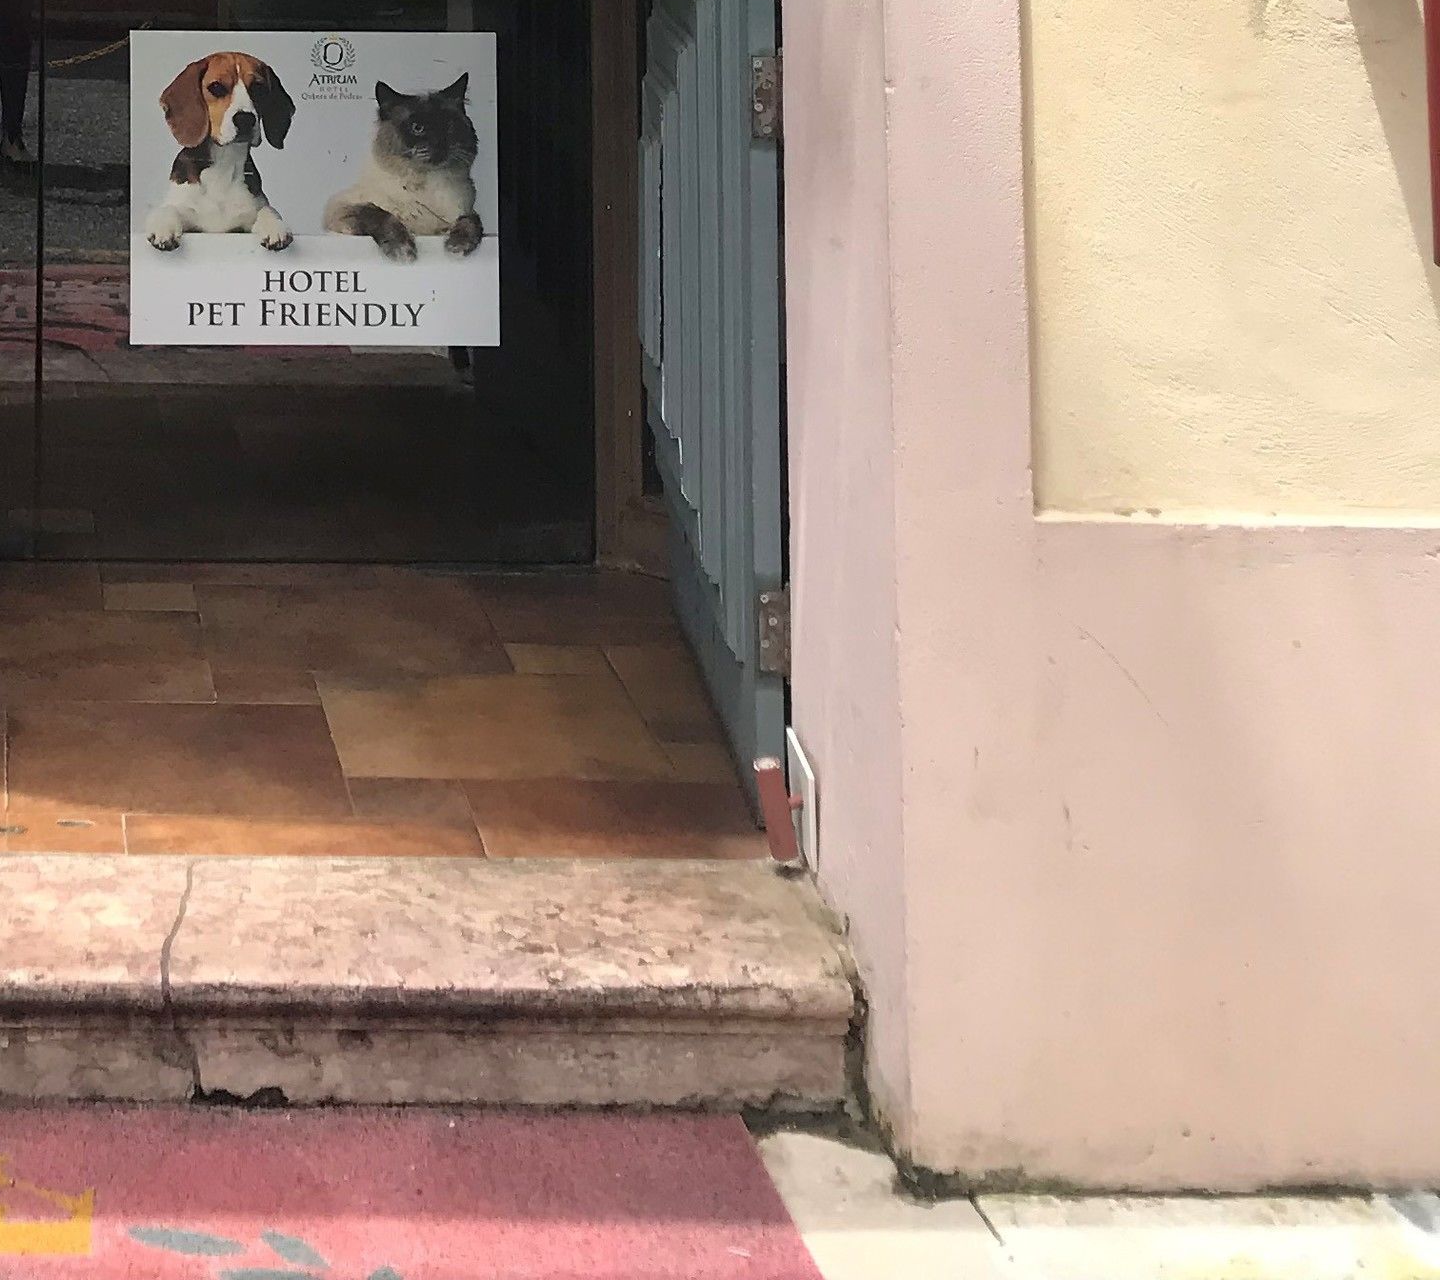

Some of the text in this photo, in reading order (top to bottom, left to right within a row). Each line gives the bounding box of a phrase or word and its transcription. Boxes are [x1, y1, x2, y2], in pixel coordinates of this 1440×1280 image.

[308, 73, 358, 88] ATRIUM
[261, 269, 367, 293] HOTEL
[187, 298, 426, 328] PET FRIENDLY
